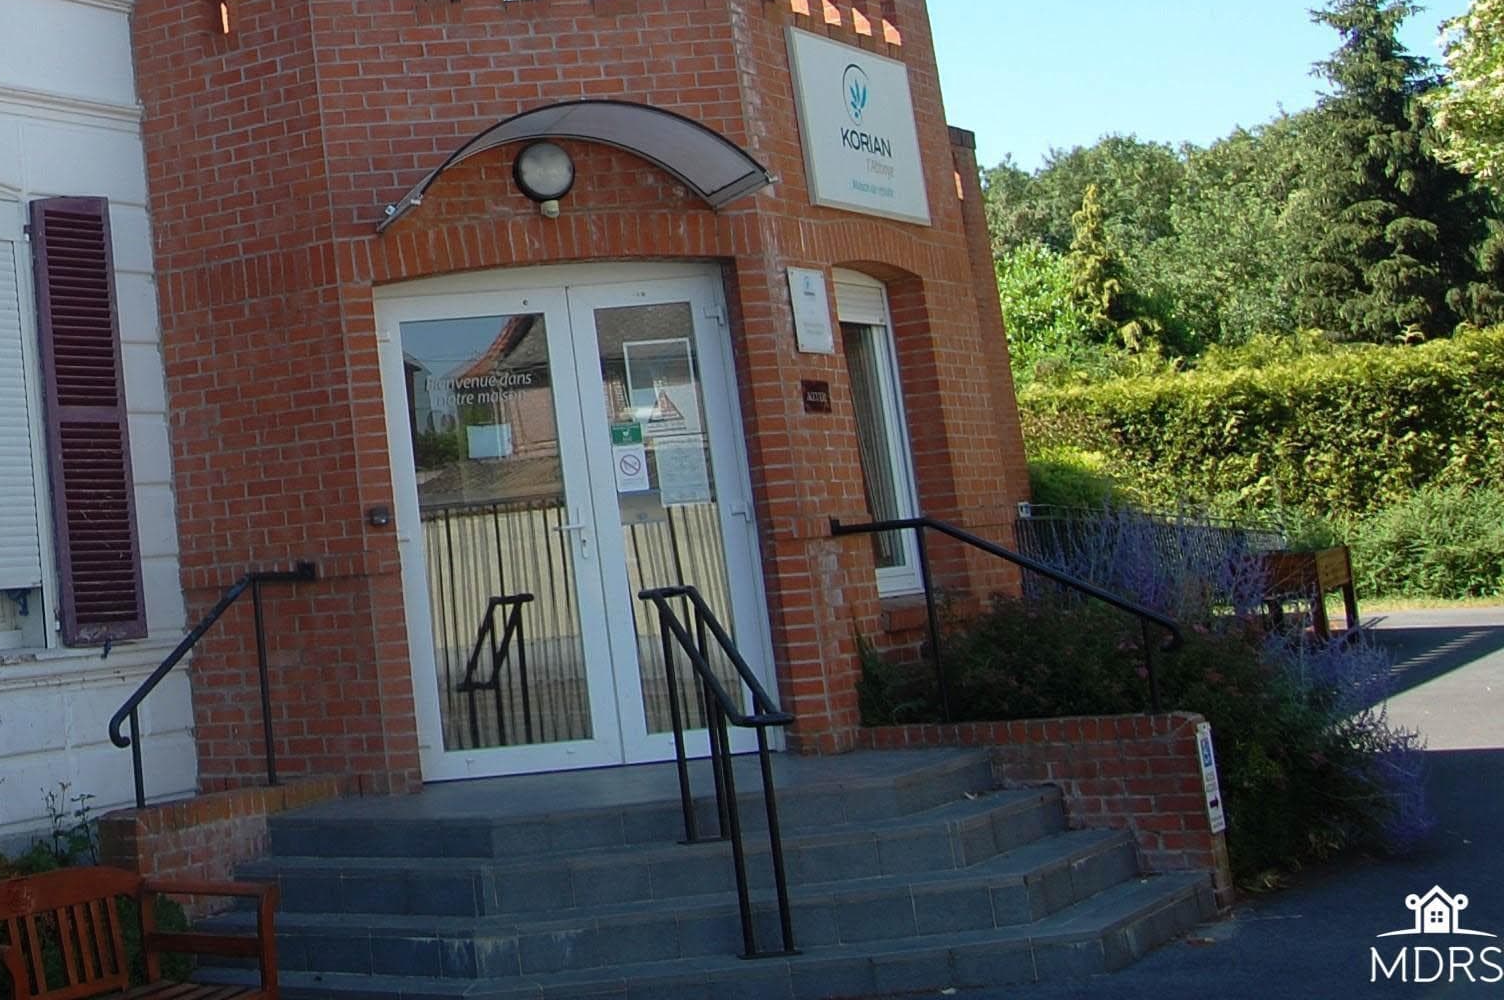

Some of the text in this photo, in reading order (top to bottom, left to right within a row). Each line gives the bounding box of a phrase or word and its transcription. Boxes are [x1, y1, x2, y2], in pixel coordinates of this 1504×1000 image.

[840, 127, 892, 158] KORIAN
[426, 371, 533, 392] Bienvenue dans
[477, 388, 527, 404] maison
